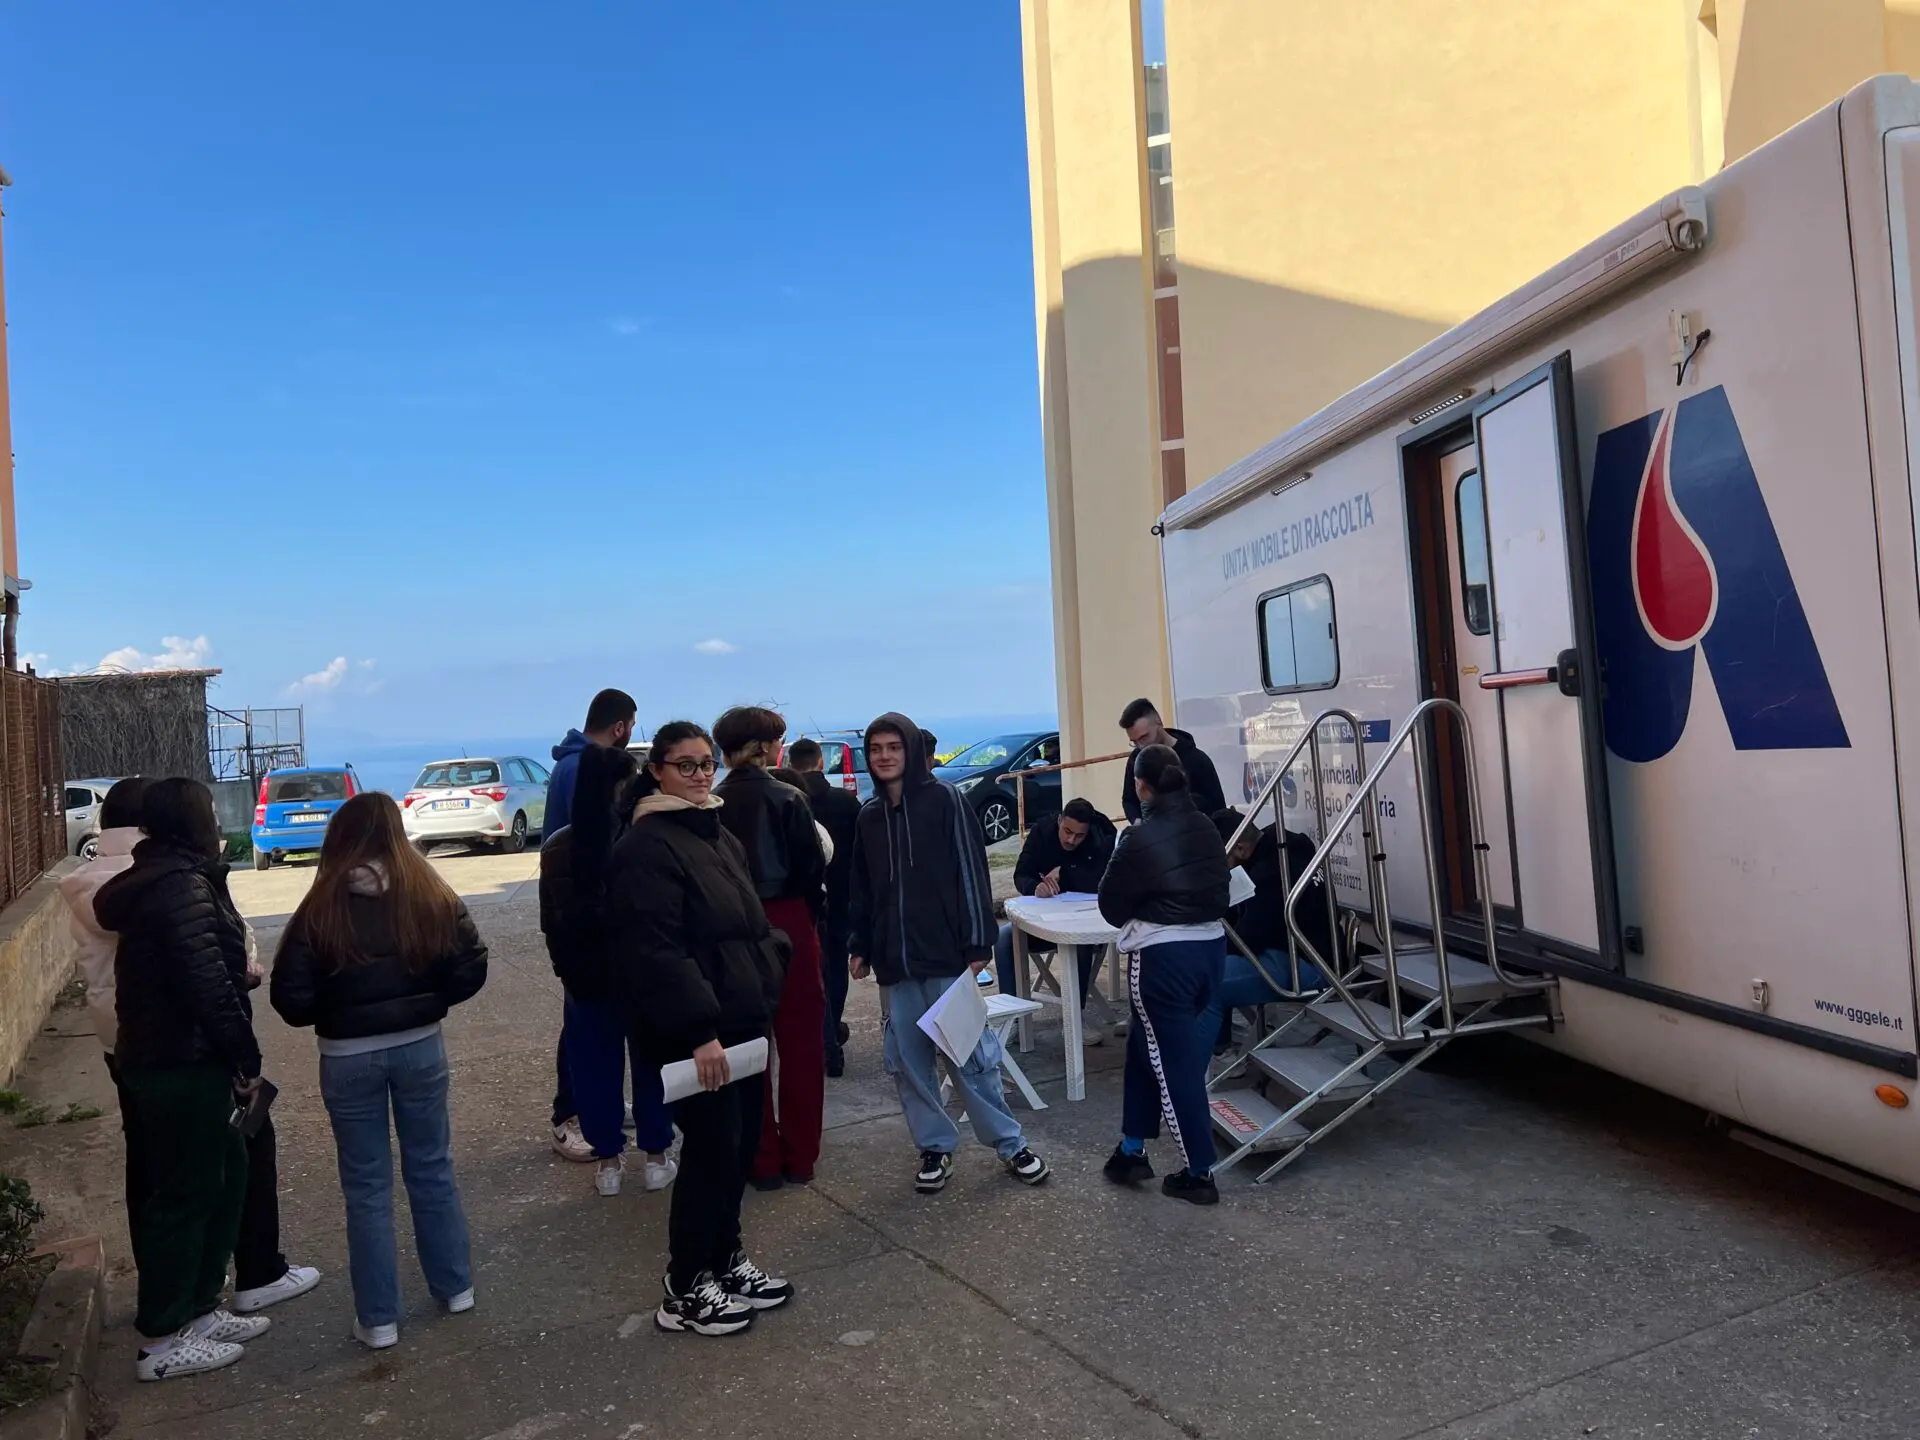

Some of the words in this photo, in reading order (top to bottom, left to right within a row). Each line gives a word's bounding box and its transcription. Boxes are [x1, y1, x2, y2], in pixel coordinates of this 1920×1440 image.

[1251, 526, 1289, 569] MOBILE
[1291, 520, 1303, 555] DI
[1305, 492, 1374, 548] RACCOLTA
[1814, 999, 1903, 1030] www.gggele.it
